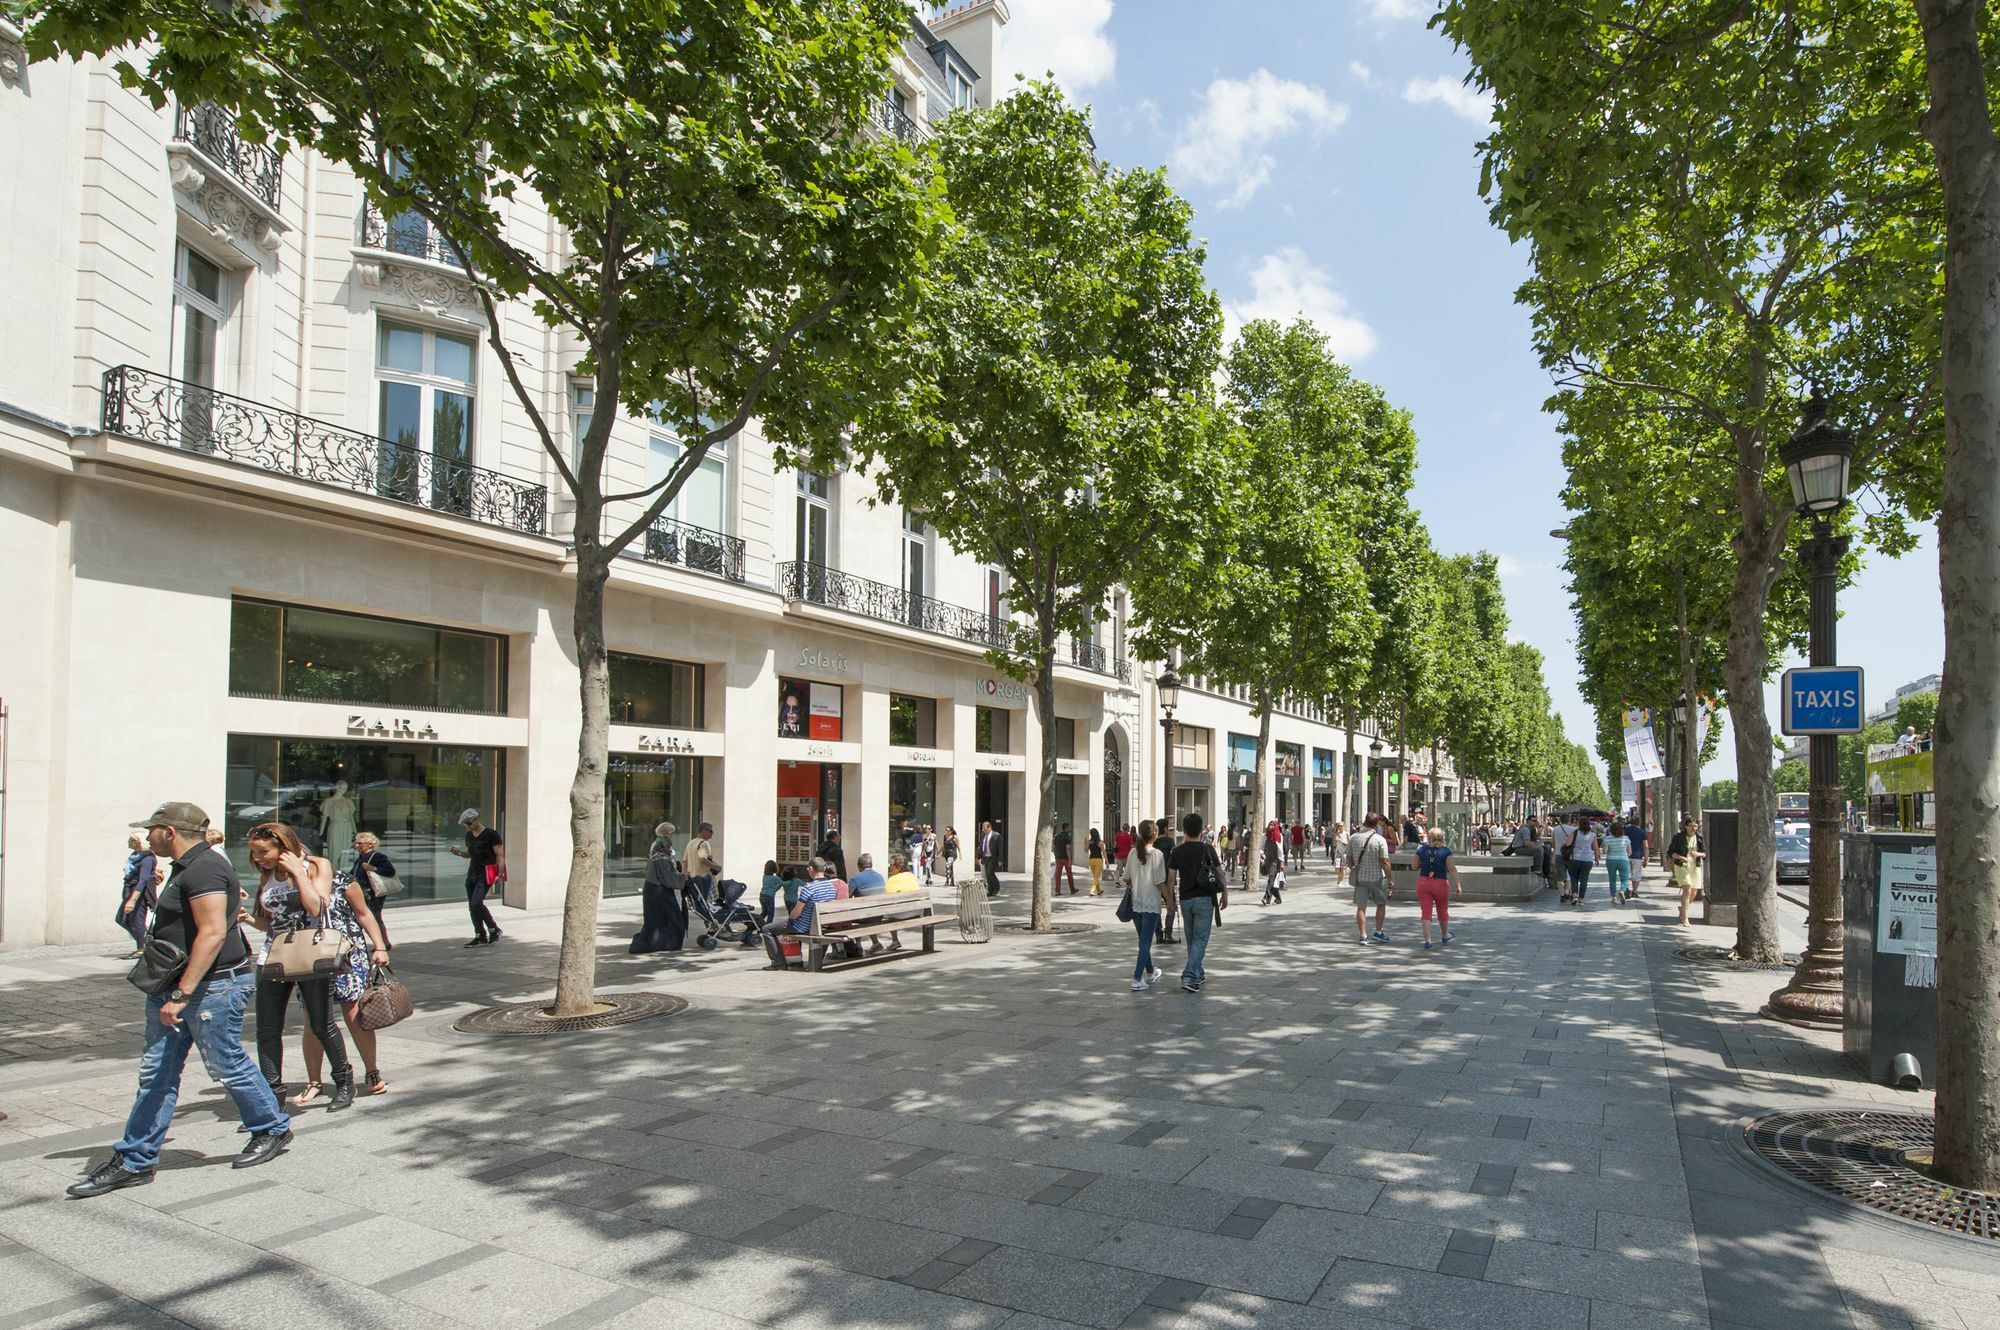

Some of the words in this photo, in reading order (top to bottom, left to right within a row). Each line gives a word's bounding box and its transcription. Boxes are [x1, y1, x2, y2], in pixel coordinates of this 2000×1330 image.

[799, 647, 848, 672] Solaris
[976, 678, 1028, 701] MORGAN
[1794, 689, 1857, 709] TAXIS
[347, 714, 438, 740] ZARA
[639, 734, 695, 753] ZARA
